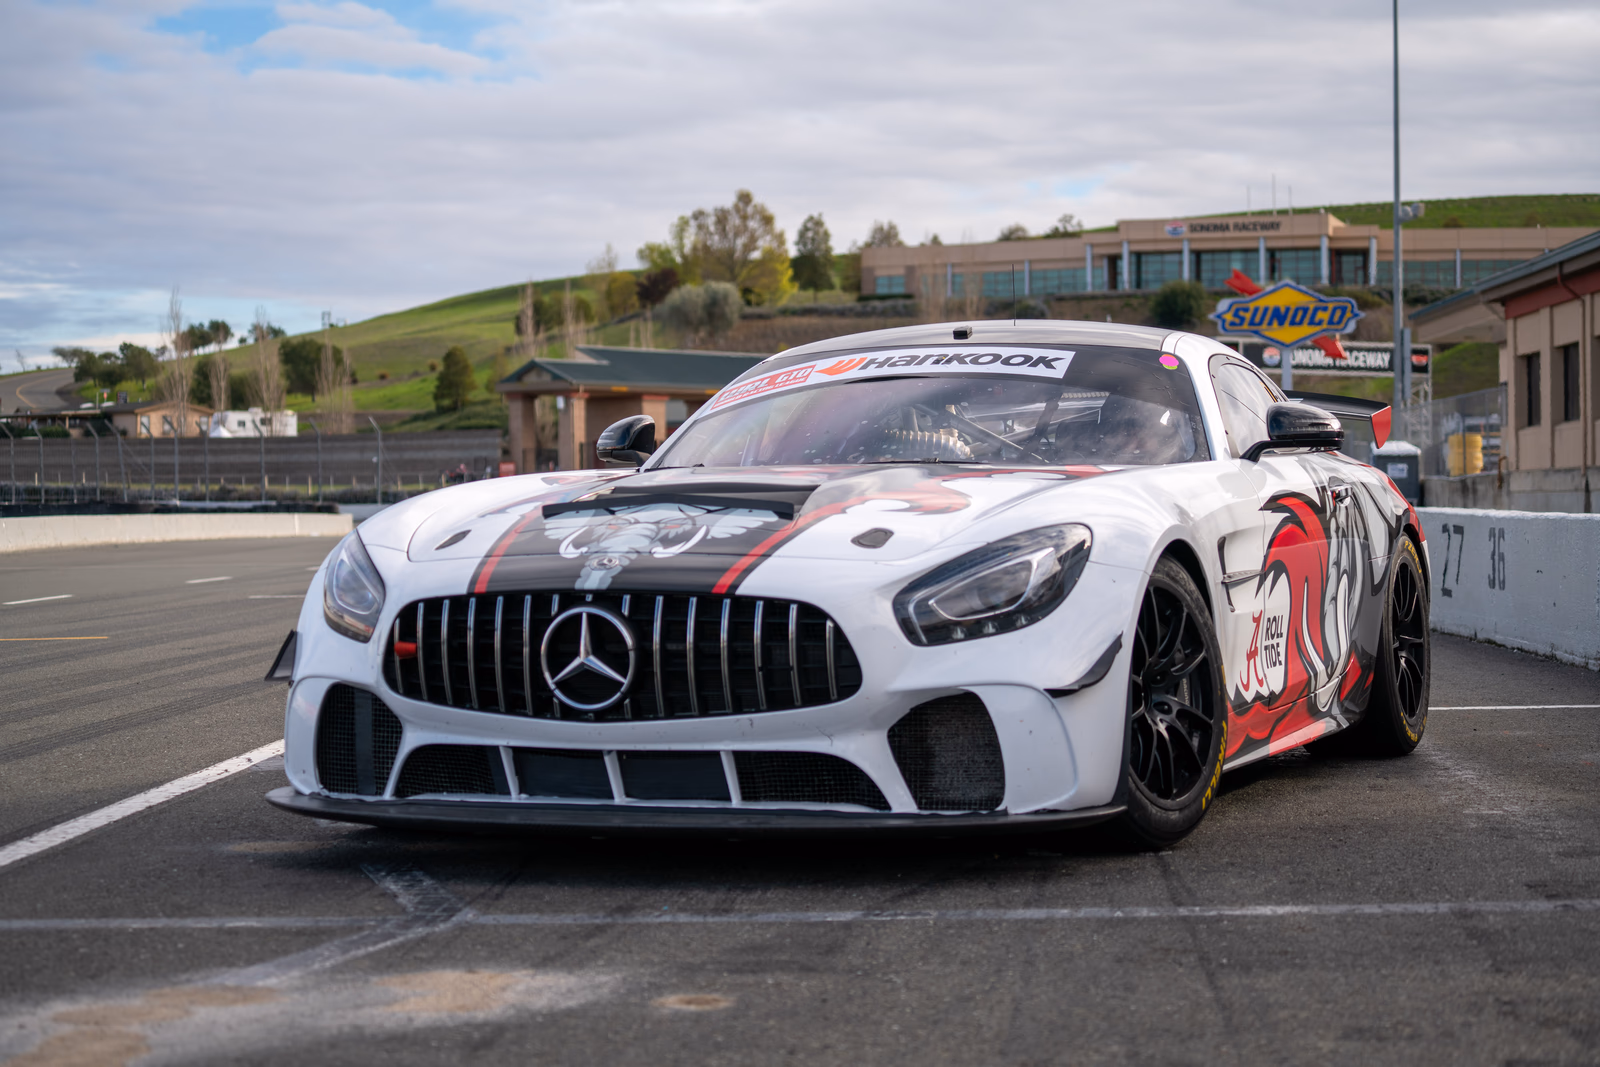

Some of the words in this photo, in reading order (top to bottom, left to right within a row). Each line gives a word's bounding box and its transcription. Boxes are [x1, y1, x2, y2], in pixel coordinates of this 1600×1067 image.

[1189, 222, 1230, 233] SONOMA
[1233, 221, 1281, 232] RACEWAY
[1228, 305, 1348, 327] SUNOCO
[1290, 349, 1334, 367] ONOMA
[775, 367, 813, 384] GTO
[1441, 523, 1464, 598] 27
[1487, 527, 1506, 591] 36
[1264, 614, 1283, 642] ROLL
[1263, 642, 1283, 669] TIDE
[1202, 720, 1227, 811] PIRELLI
